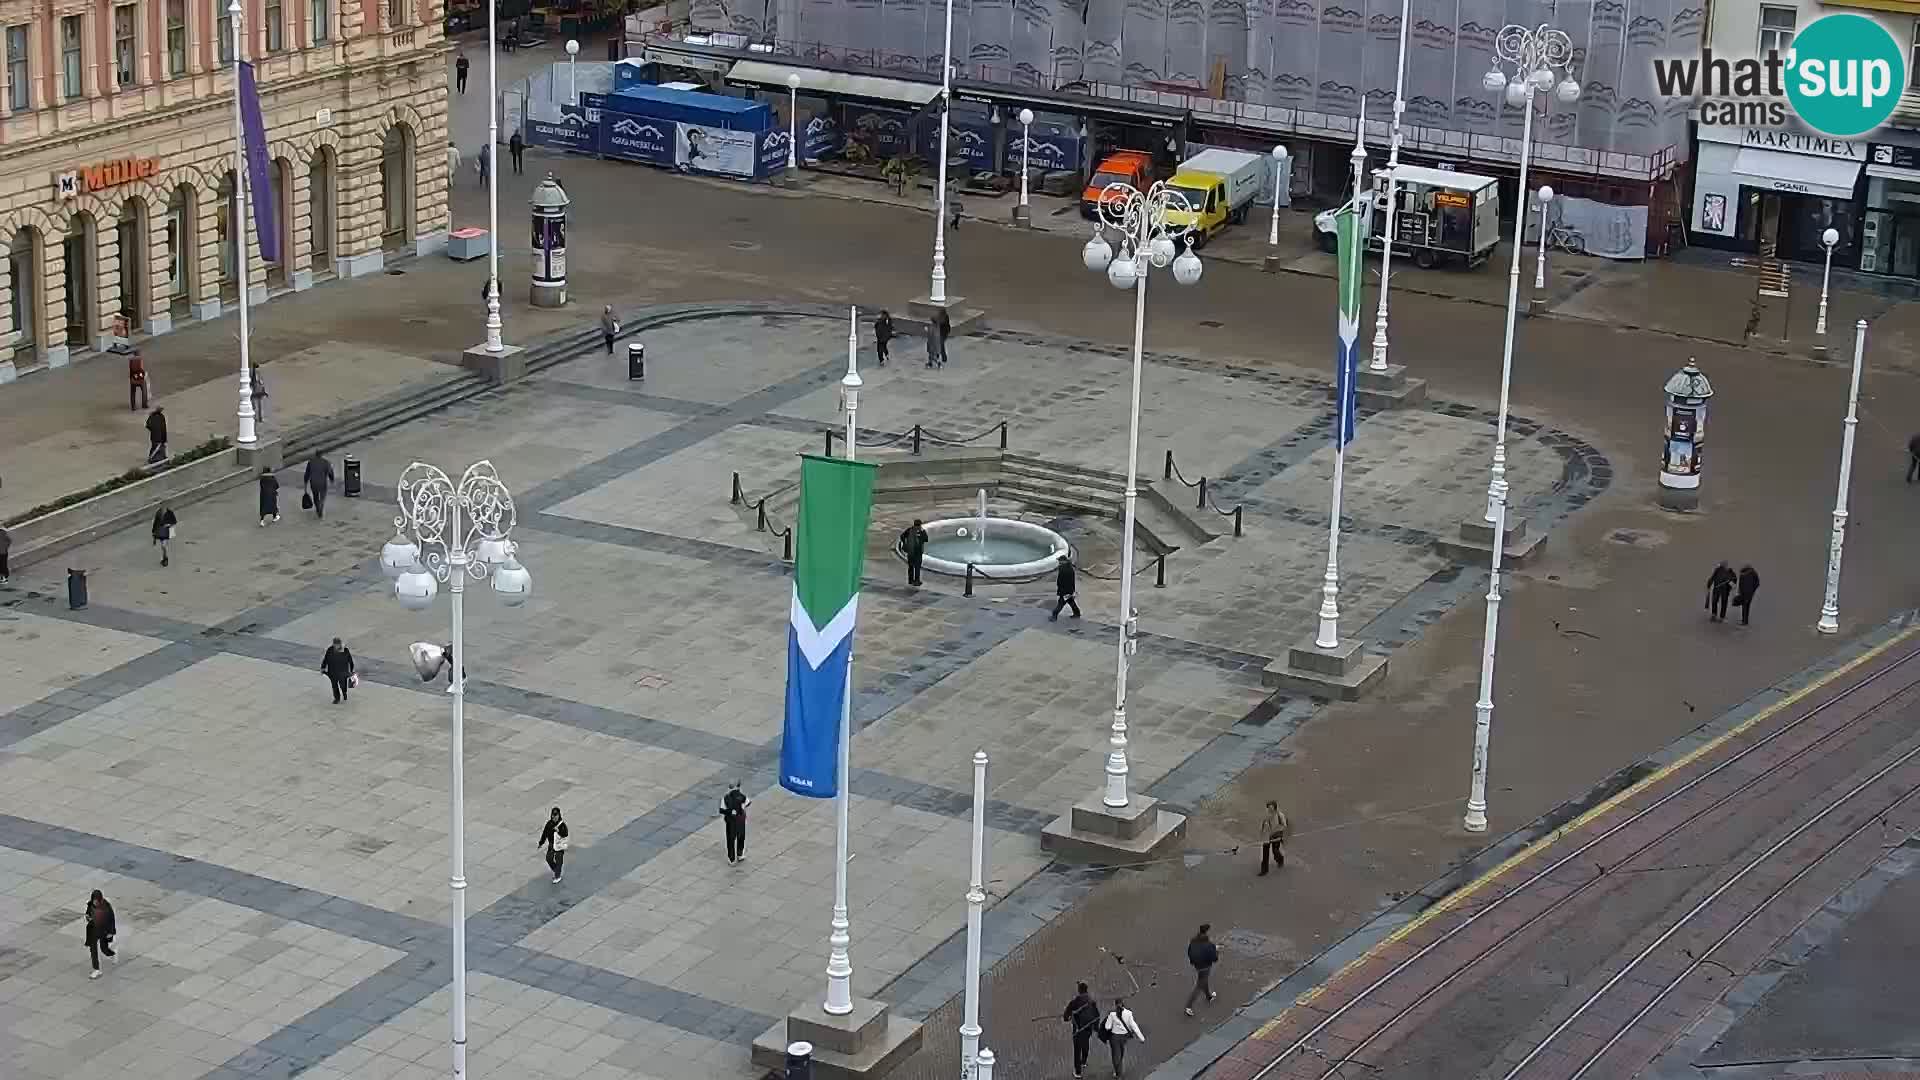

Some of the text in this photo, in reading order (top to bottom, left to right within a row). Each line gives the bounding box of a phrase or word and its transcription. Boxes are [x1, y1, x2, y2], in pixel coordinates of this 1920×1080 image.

[1746, 130, 1857, 157] MARTIMEX
[81, 157, 160, 191] Müller
[1773, 181, 1809, 193] CHANEL
